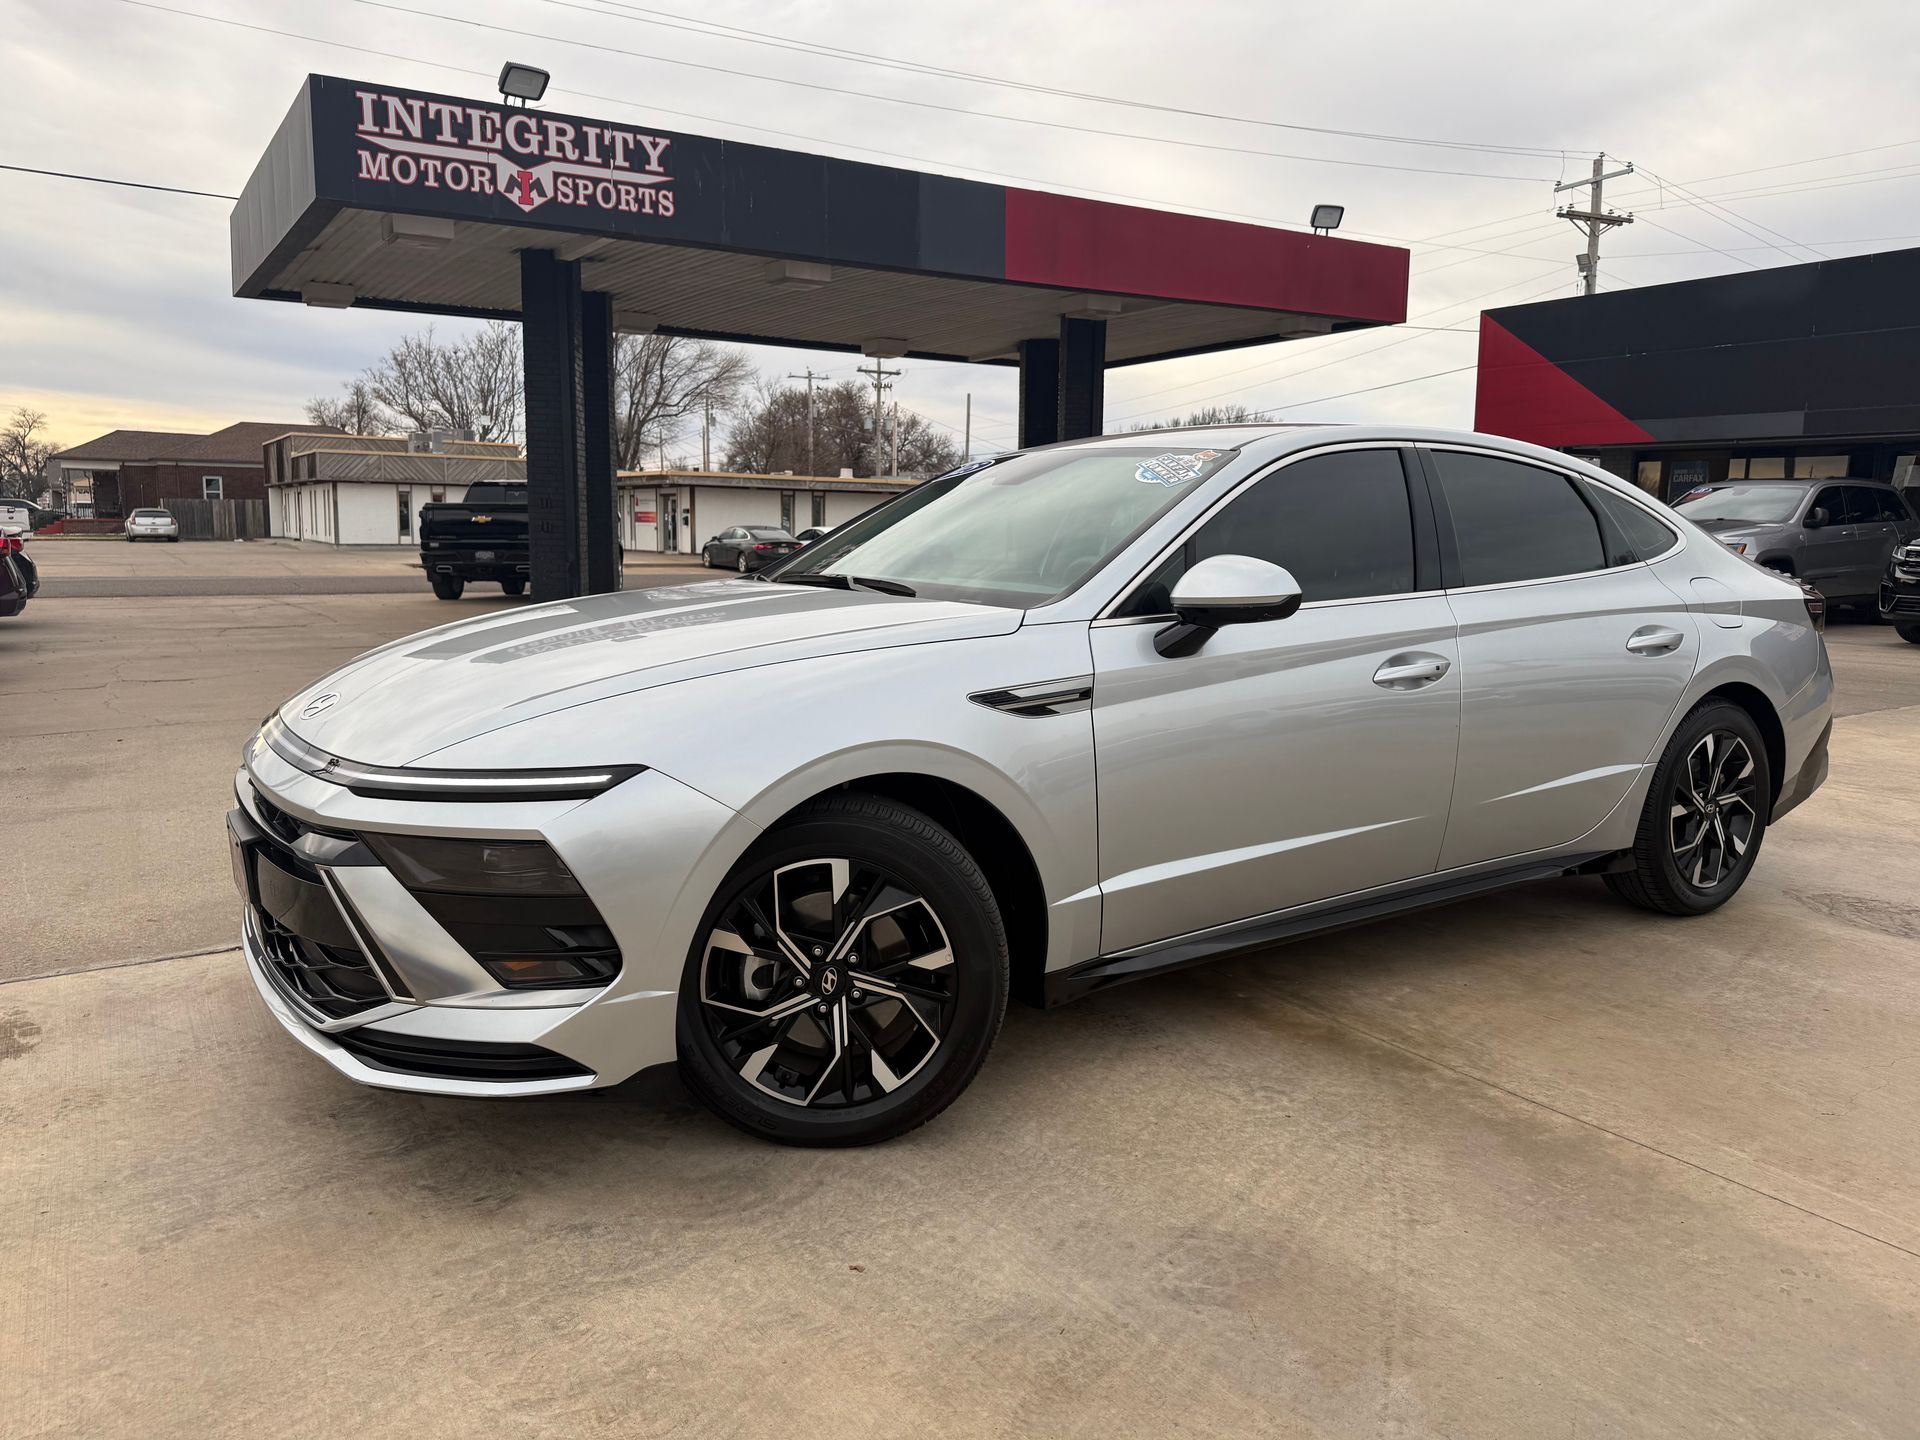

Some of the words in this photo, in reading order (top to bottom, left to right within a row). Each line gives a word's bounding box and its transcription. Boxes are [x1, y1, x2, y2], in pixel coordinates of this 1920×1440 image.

[355, 90, 671, 173] INTEGRITY
[357, 149, 494, 194] MOTOR
[556, 176, 675, 217] SPORTS
[1672, 474, 1704, 483] CARFAX
